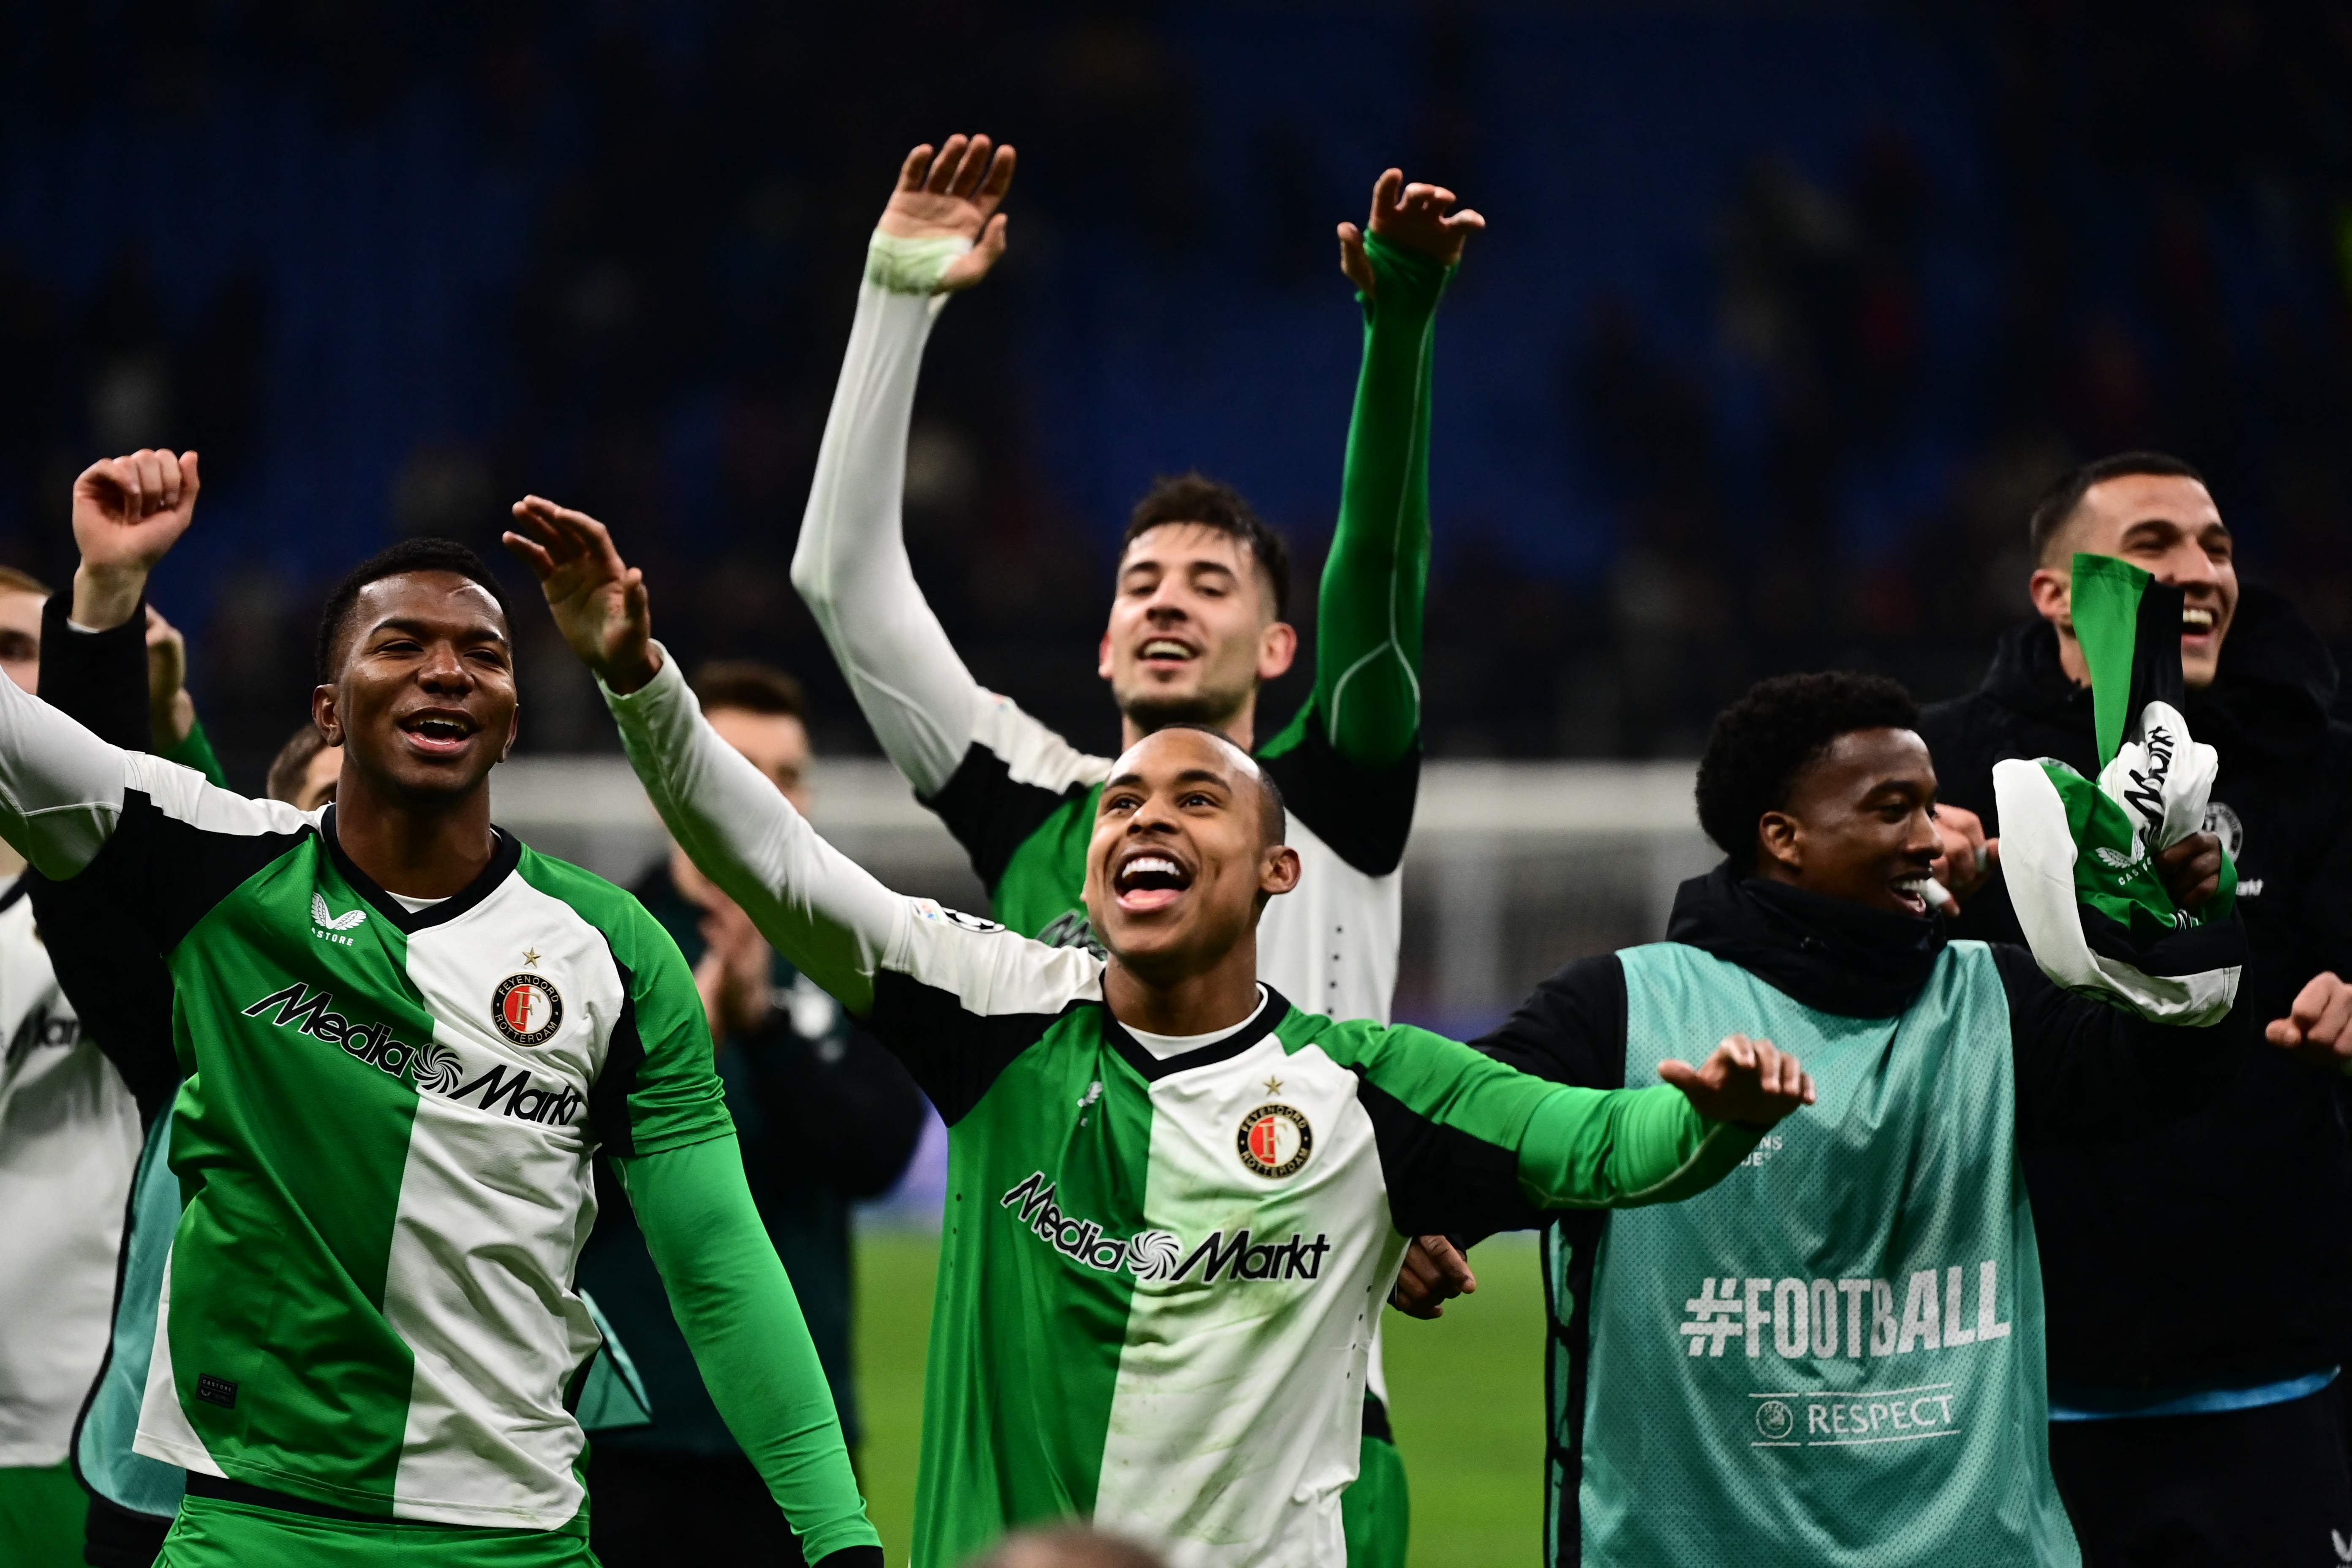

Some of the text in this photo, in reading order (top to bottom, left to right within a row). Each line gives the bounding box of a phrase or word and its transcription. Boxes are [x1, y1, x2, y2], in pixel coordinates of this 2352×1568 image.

[498, 975, 559, 1003] FEYENOORD
[495, 1013, 558, 1043] ROTTERDAM
[241, 982, 582, 1126] Media Markt
[1000, 1171, 1330, 1284] Media Markt
[1680, 1260, 2011, 1358] #FOOTBALL
[202, 1379, 231, 1392] CASTORE
[1808, 1395, 1954, 1435] RESPECT
